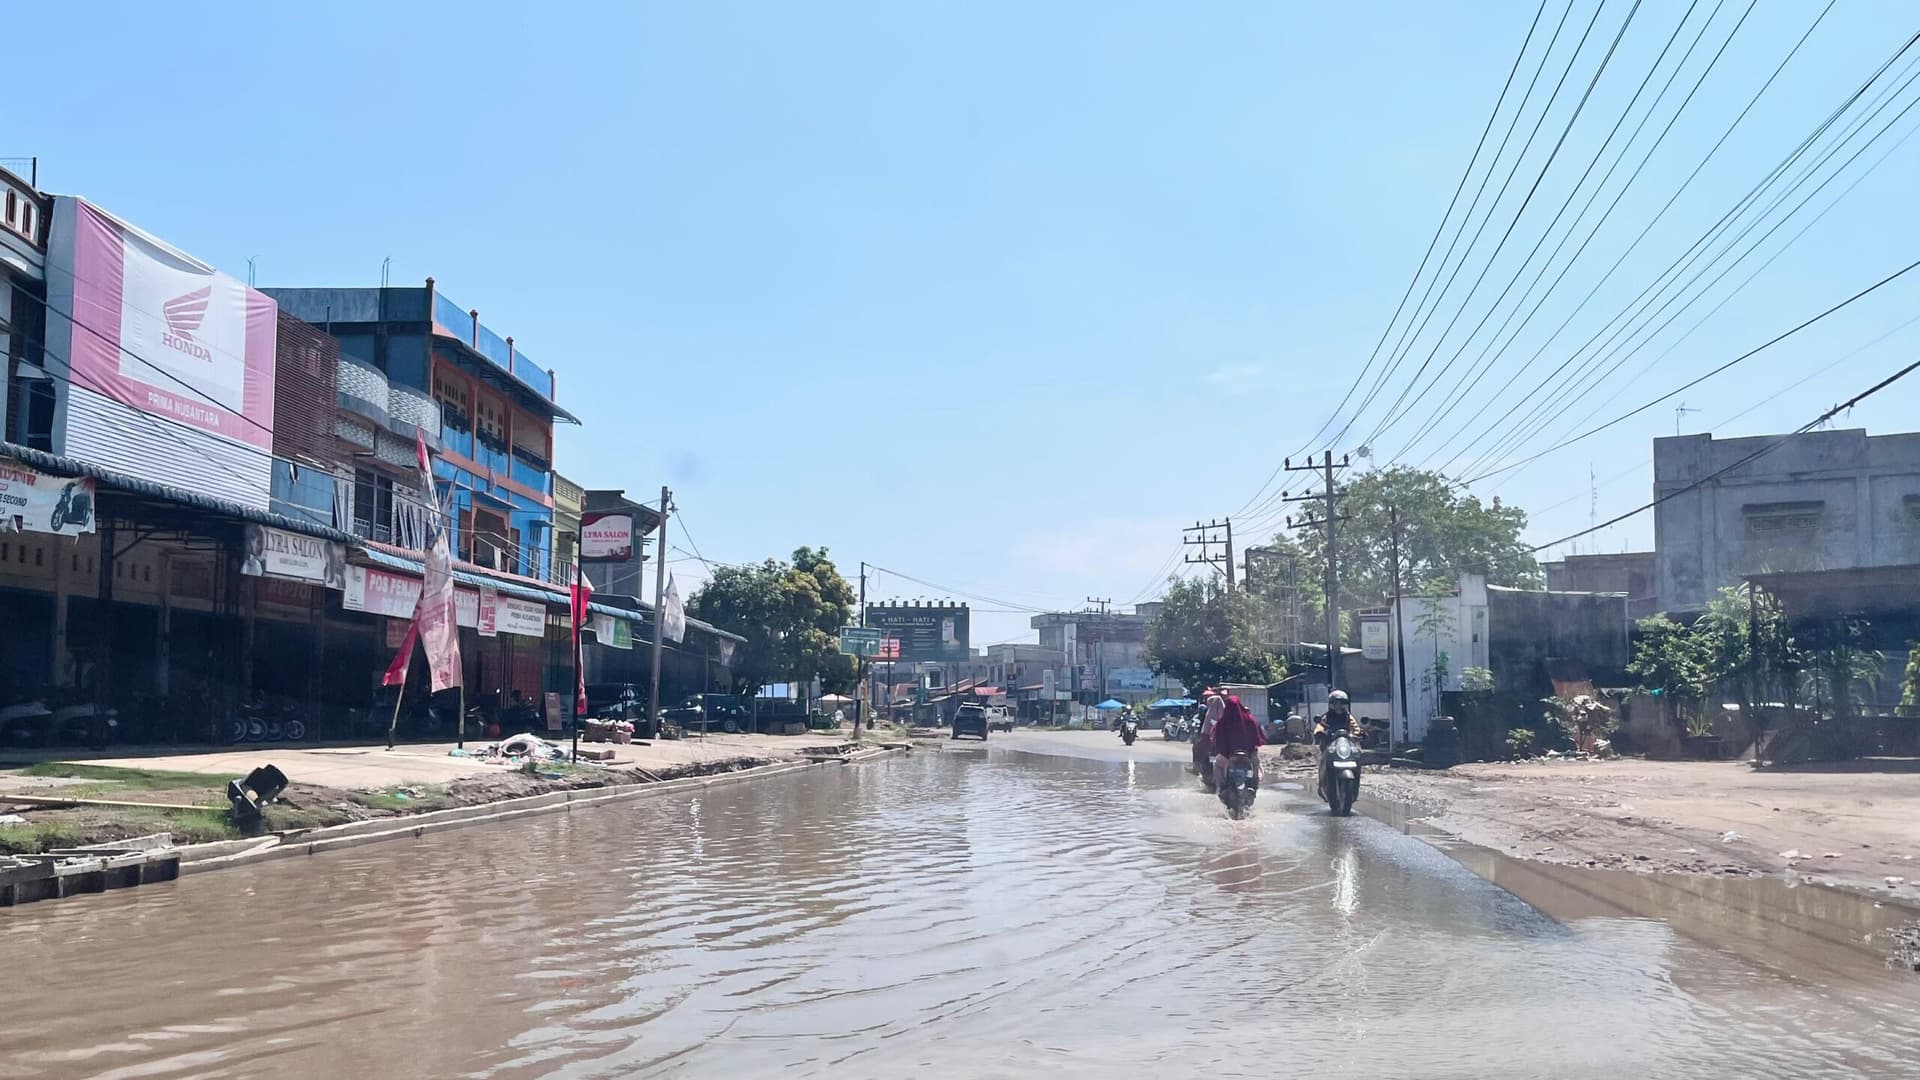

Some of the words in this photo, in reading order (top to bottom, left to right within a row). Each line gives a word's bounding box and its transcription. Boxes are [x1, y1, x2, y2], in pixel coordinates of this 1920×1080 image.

[162, 332, 212, 363] HONDA
[147, 391, 173, 413] PRIMA
[174, 402, 219, 426] NUSANTARA
[3, 494, 28, 507] SECOND
[265, 531, 290, 554] LYRA
[292, 537, 324, 560] SALON
[584, 530, 602, 538] LYRA
[603, 530, 628, 538] SALON
[369, 573, 389, 593] POS
